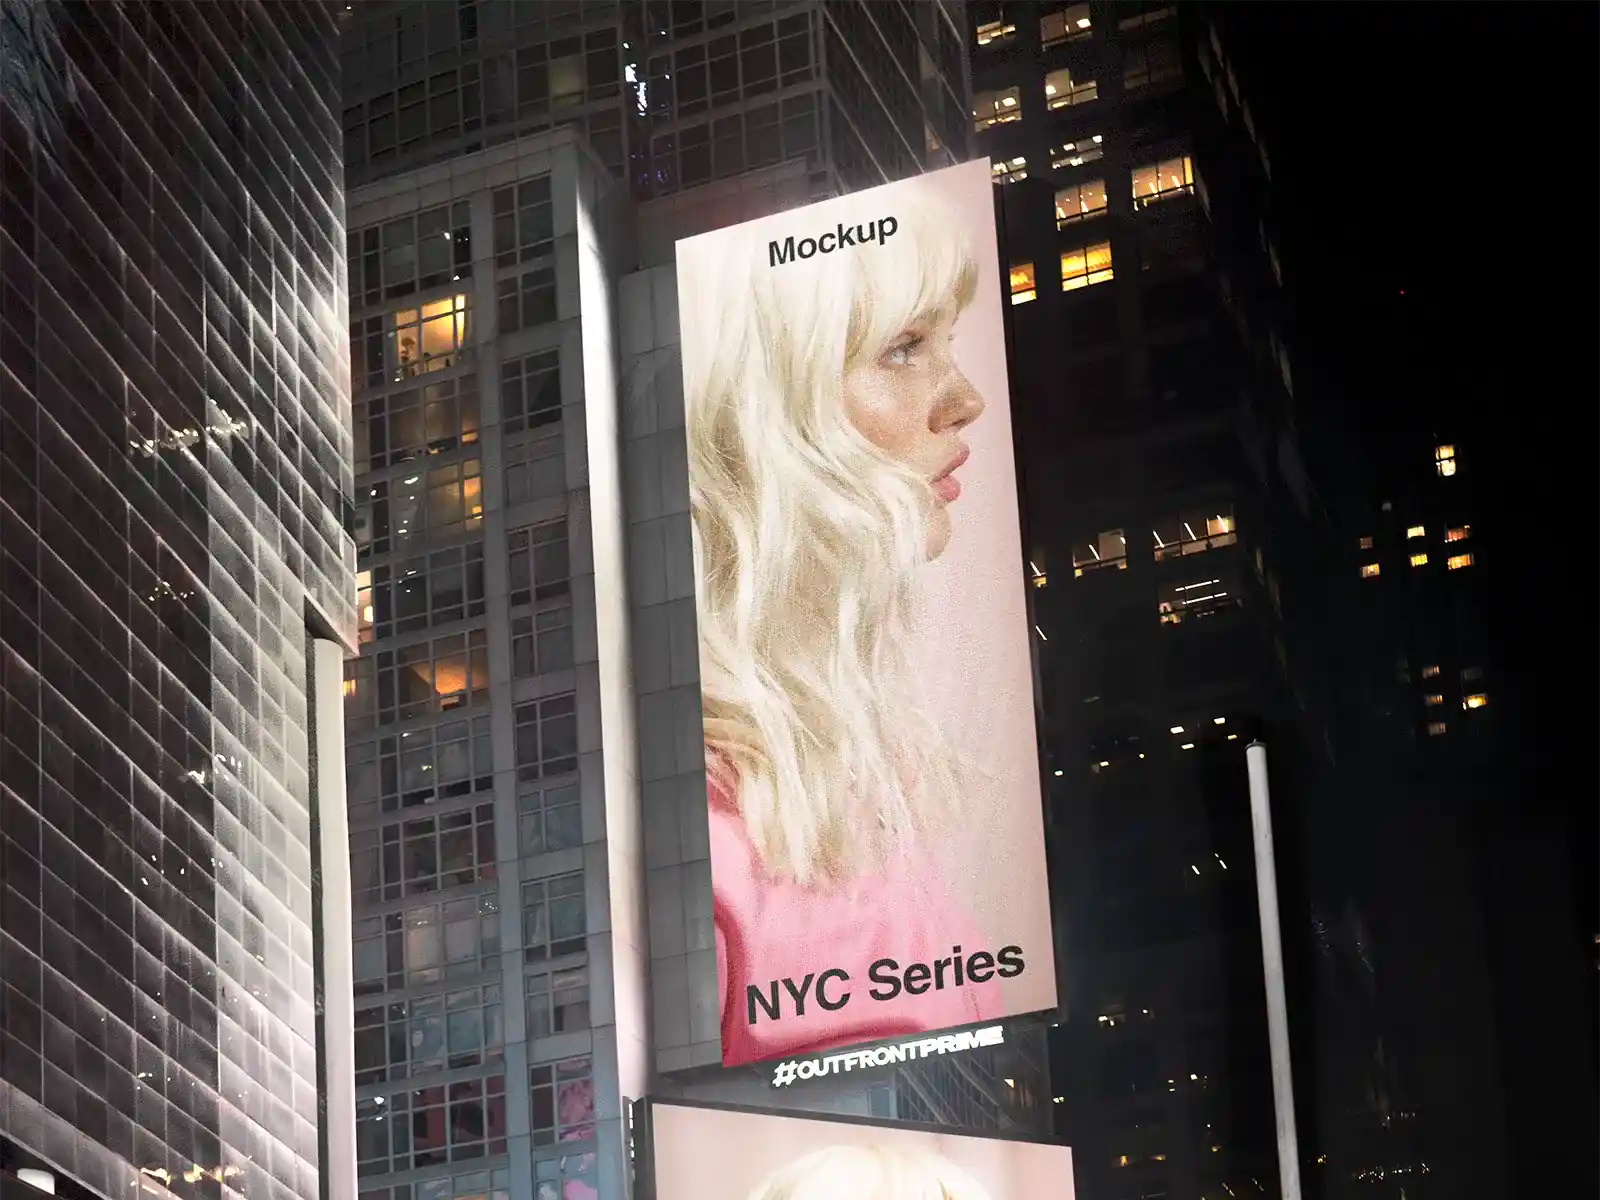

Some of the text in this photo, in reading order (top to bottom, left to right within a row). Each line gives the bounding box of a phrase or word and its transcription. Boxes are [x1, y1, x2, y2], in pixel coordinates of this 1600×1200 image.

[767, 215, 898, 267] Mockup
[746, 945, 1026, 1025] NYC Series
[772, 1025, 1004, 1088] #OUTFRONTPRIME
